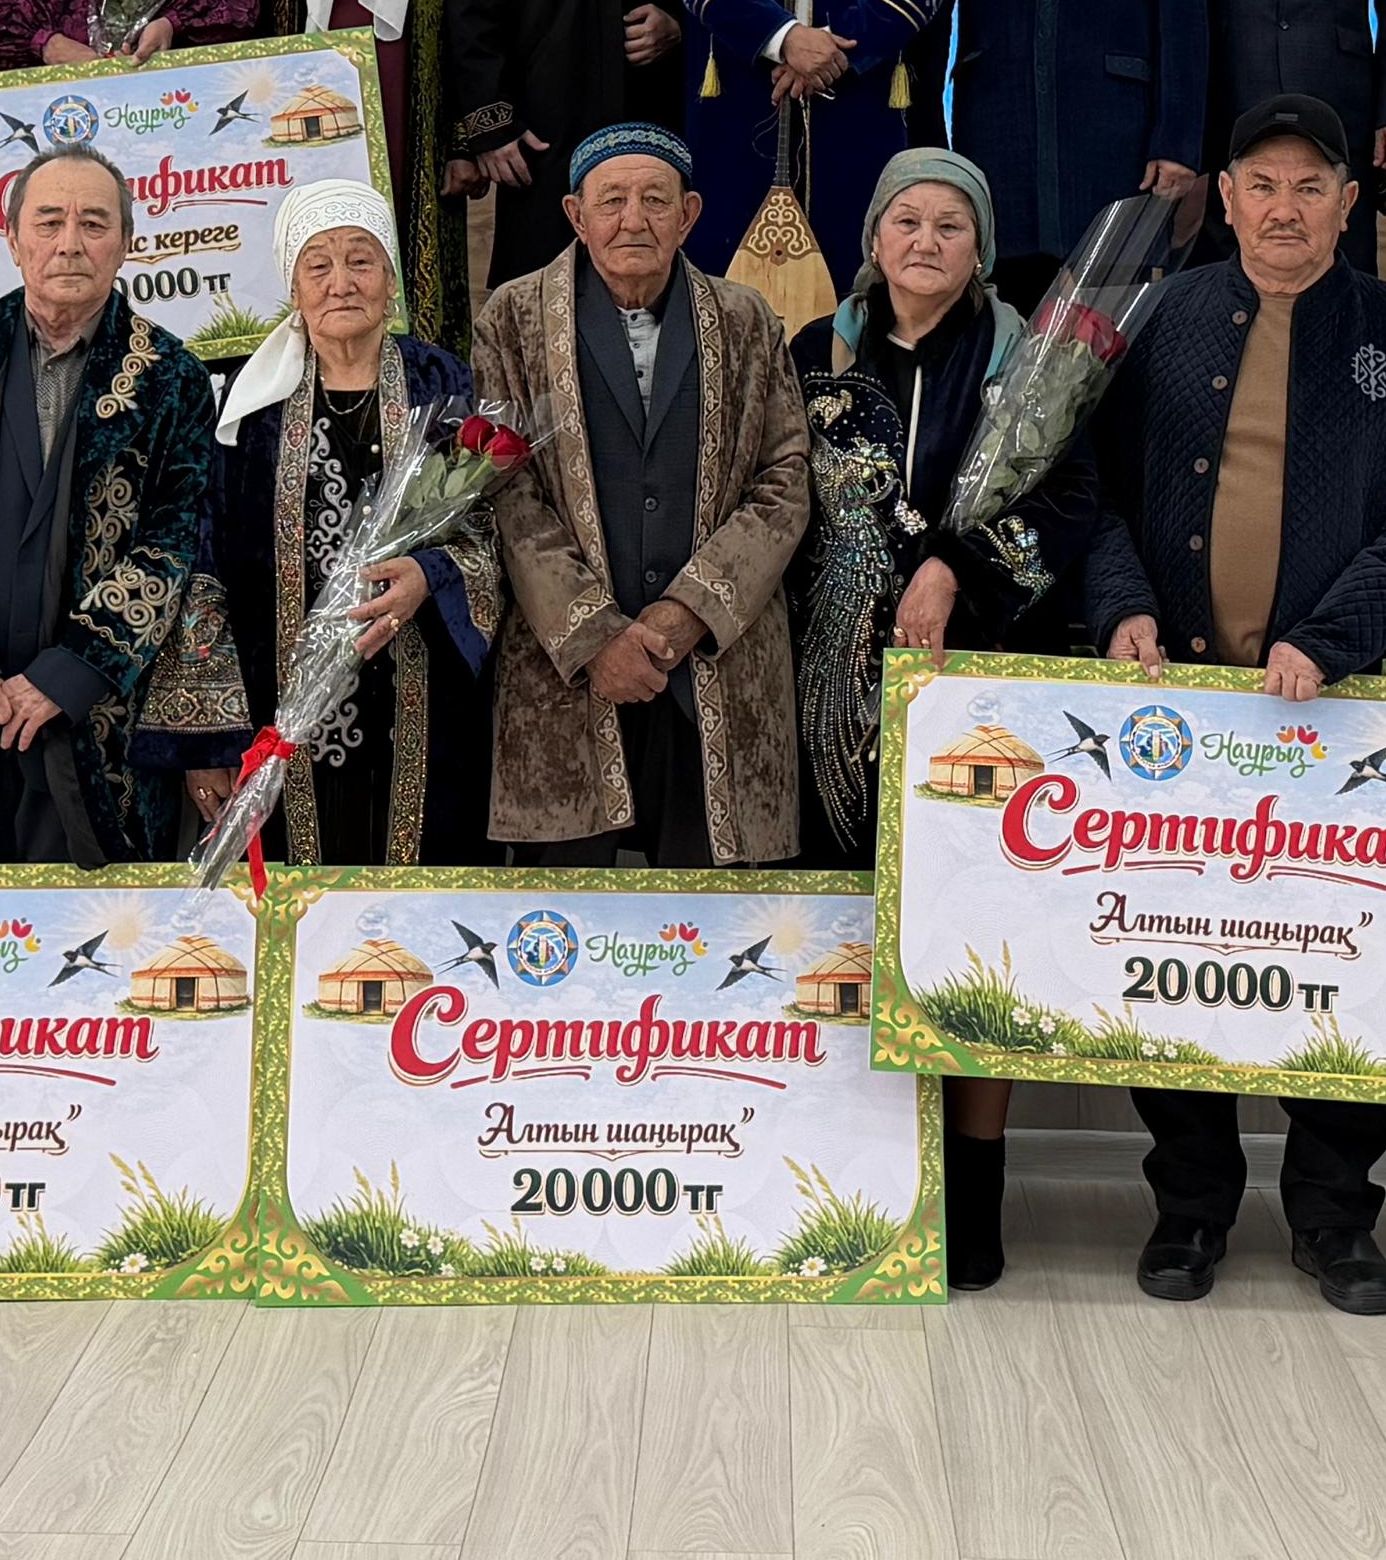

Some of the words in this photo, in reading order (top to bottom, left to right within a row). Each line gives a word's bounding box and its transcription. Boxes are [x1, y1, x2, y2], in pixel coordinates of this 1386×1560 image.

[104, 103, 192, 135] Наурыз
[155, 223, 239, 255] кереге
[1200, 732, 1317, 778] Наурыз
[1089, 890, 1212, 937] Алтын
[585, 930, 697, 977] Наурыз
[390, 984, 827, 1087] Сертификат
[477, 1102, 600, 1146] Алтын
